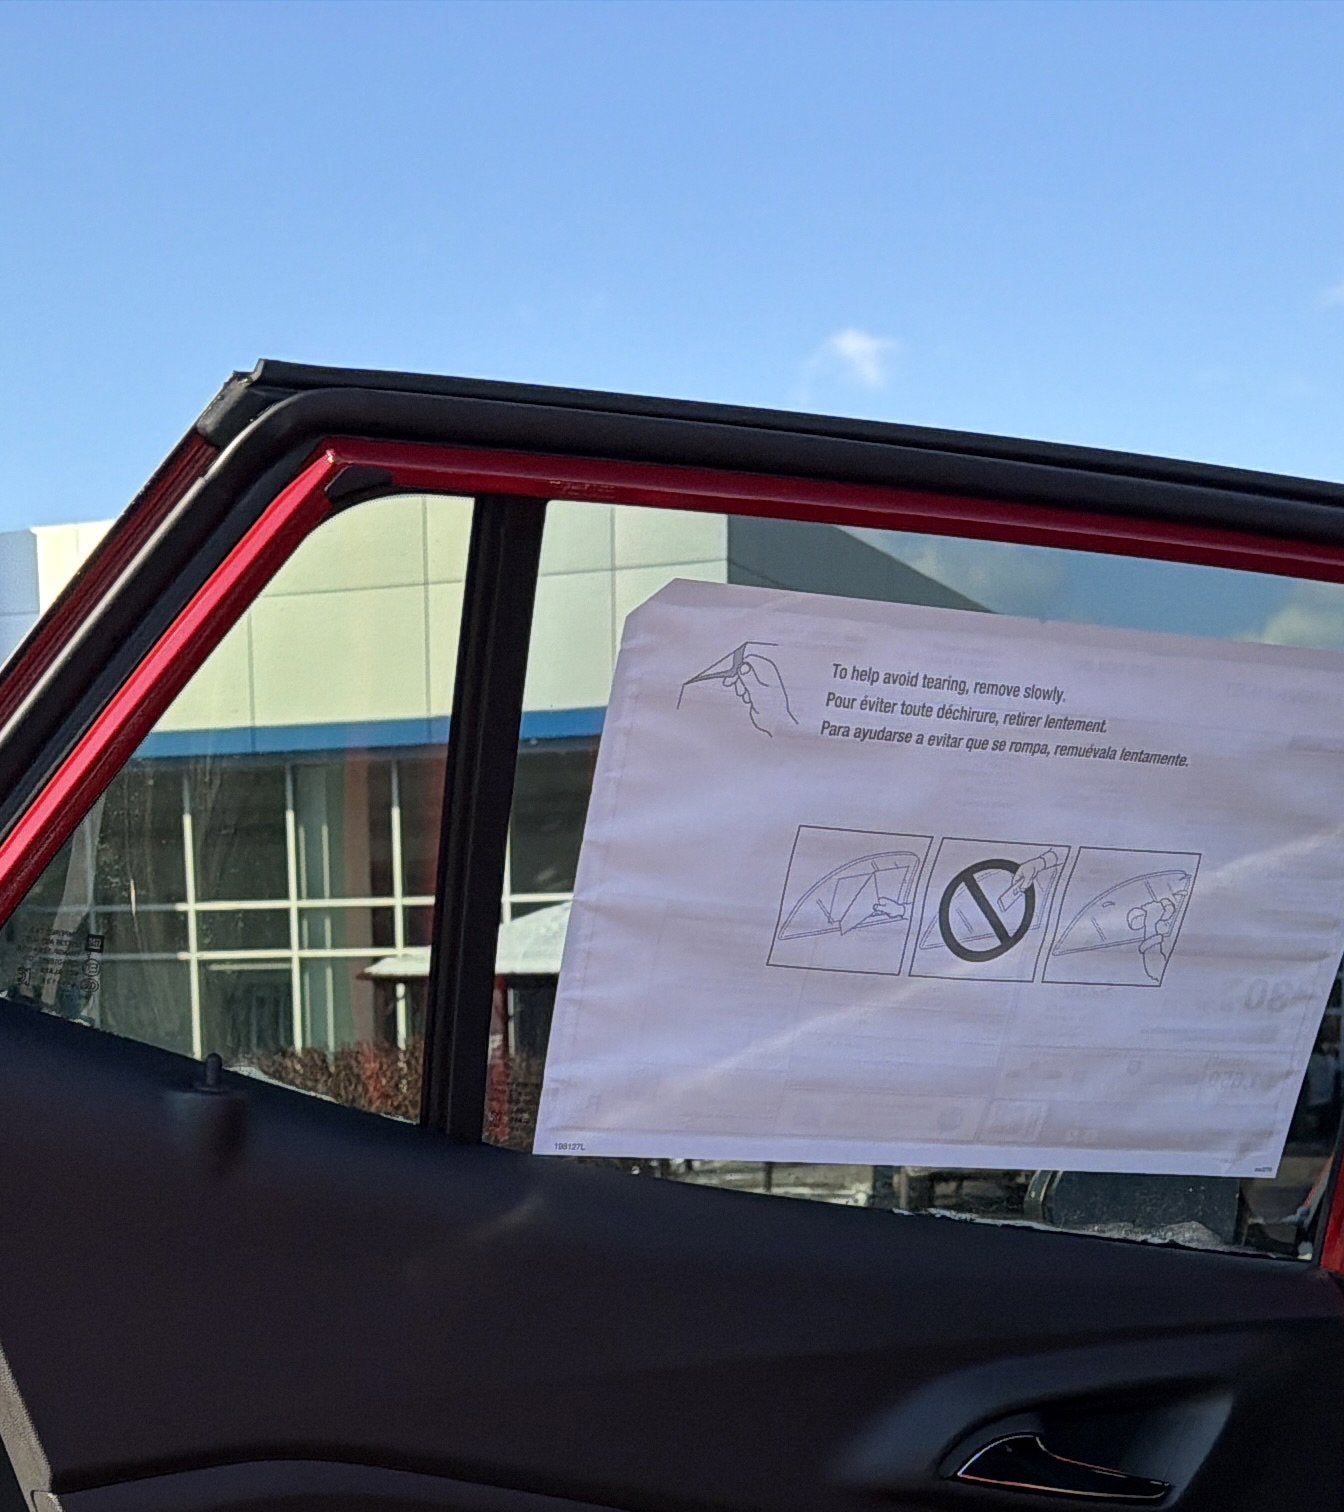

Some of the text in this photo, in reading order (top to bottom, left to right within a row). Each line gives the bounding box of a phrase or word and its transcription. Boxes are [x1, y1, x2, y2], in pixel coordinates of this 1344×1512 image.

[832, 663, 1066, 705] To help avoid tearing, remove slowly.
[825, 692, 857, 710] Pour
[860, 694, 898, 714] éviter
[900, 699, 933, 718] toute
[937, 704, 999, 727] déchirure,
[1003, 711, 1043, 728] retirer
[820, 720, 1189, 768] Para ayudarse a evitar que se rompa, remuévala lentamente.
